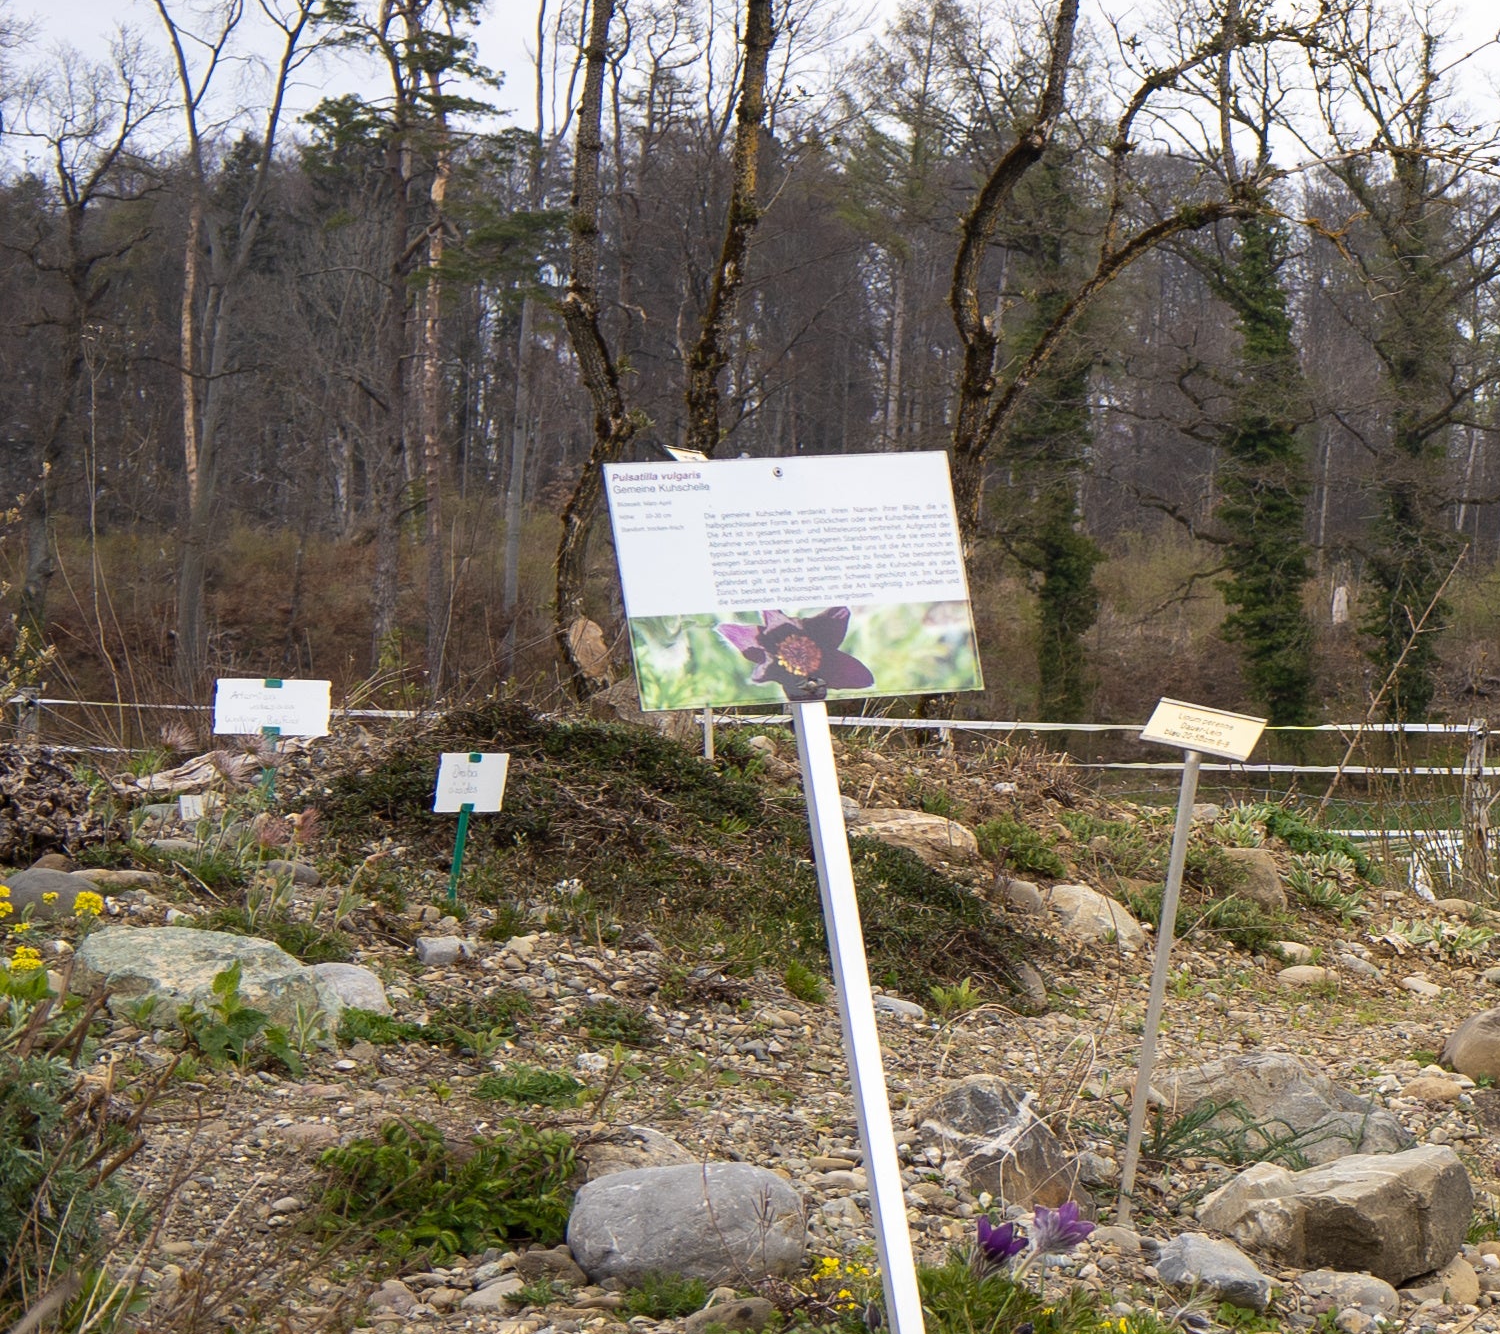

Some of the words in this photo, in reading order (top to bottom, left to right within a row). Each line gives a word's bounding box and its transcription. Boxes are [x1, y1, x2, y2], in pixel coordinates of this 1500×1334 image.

[612, 472, 658, 481] Pulsatilla
[661, 472, 701, 481] vulgaris
[613, 485, 655, 494] Gemeine
[659, 483, 710, 492] Kuhschelle
